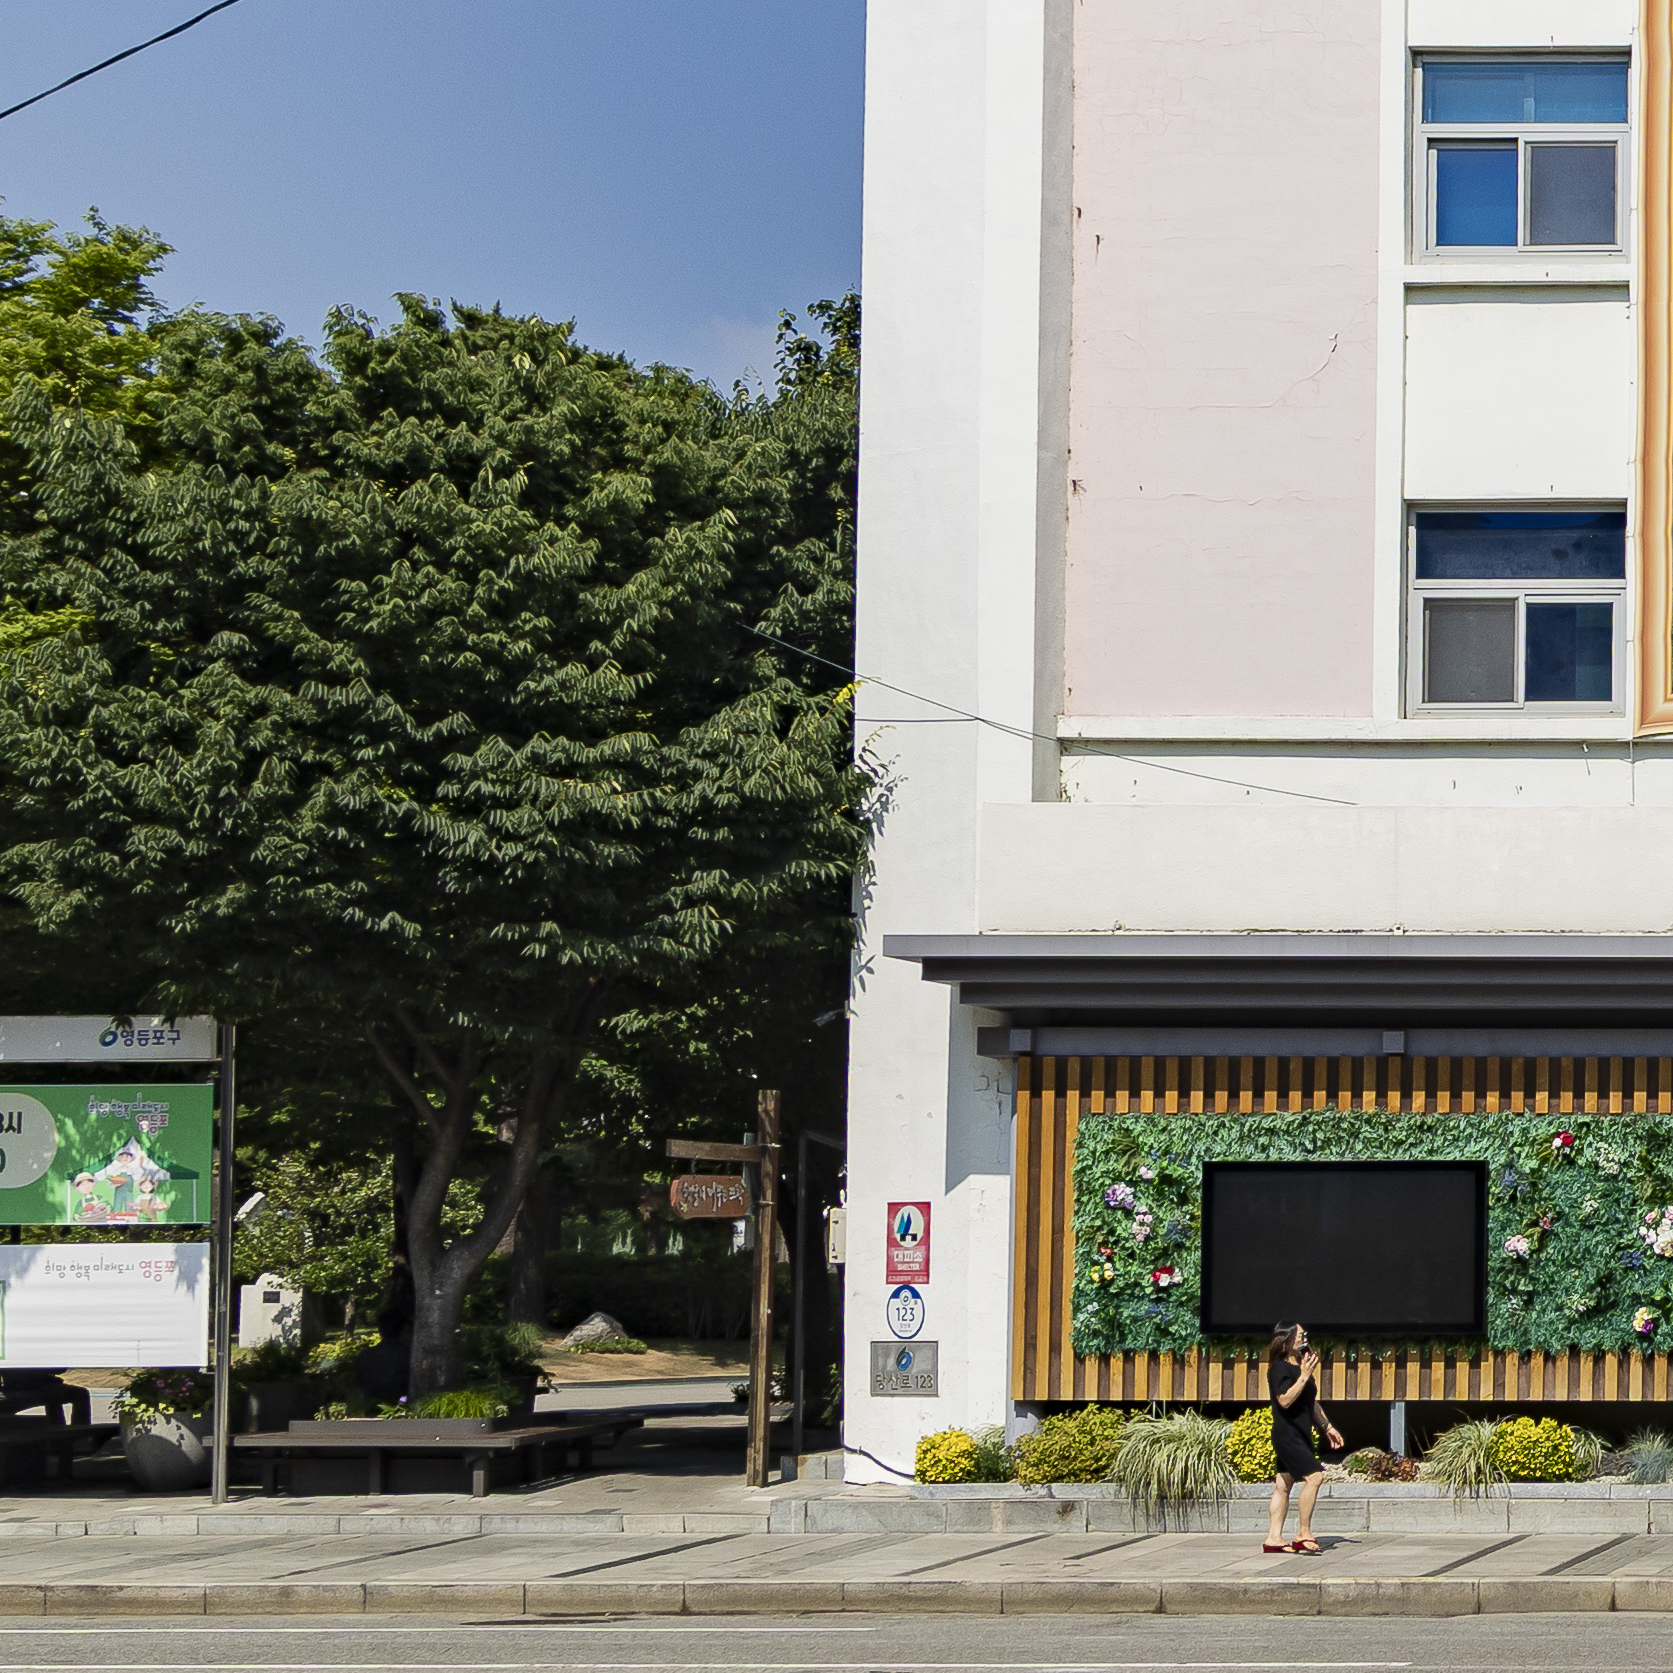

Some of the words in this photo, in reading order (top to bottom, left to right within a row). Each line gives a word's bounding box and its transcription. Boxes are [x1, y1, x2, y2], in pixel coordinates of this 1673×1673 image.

[120, 1029, 182, 1047] 영등포구
[895, 1307, 915, 1322] 123
[875, 1375, 912, 1391] 당산로
[915, 1375, 934, 1389] 123
